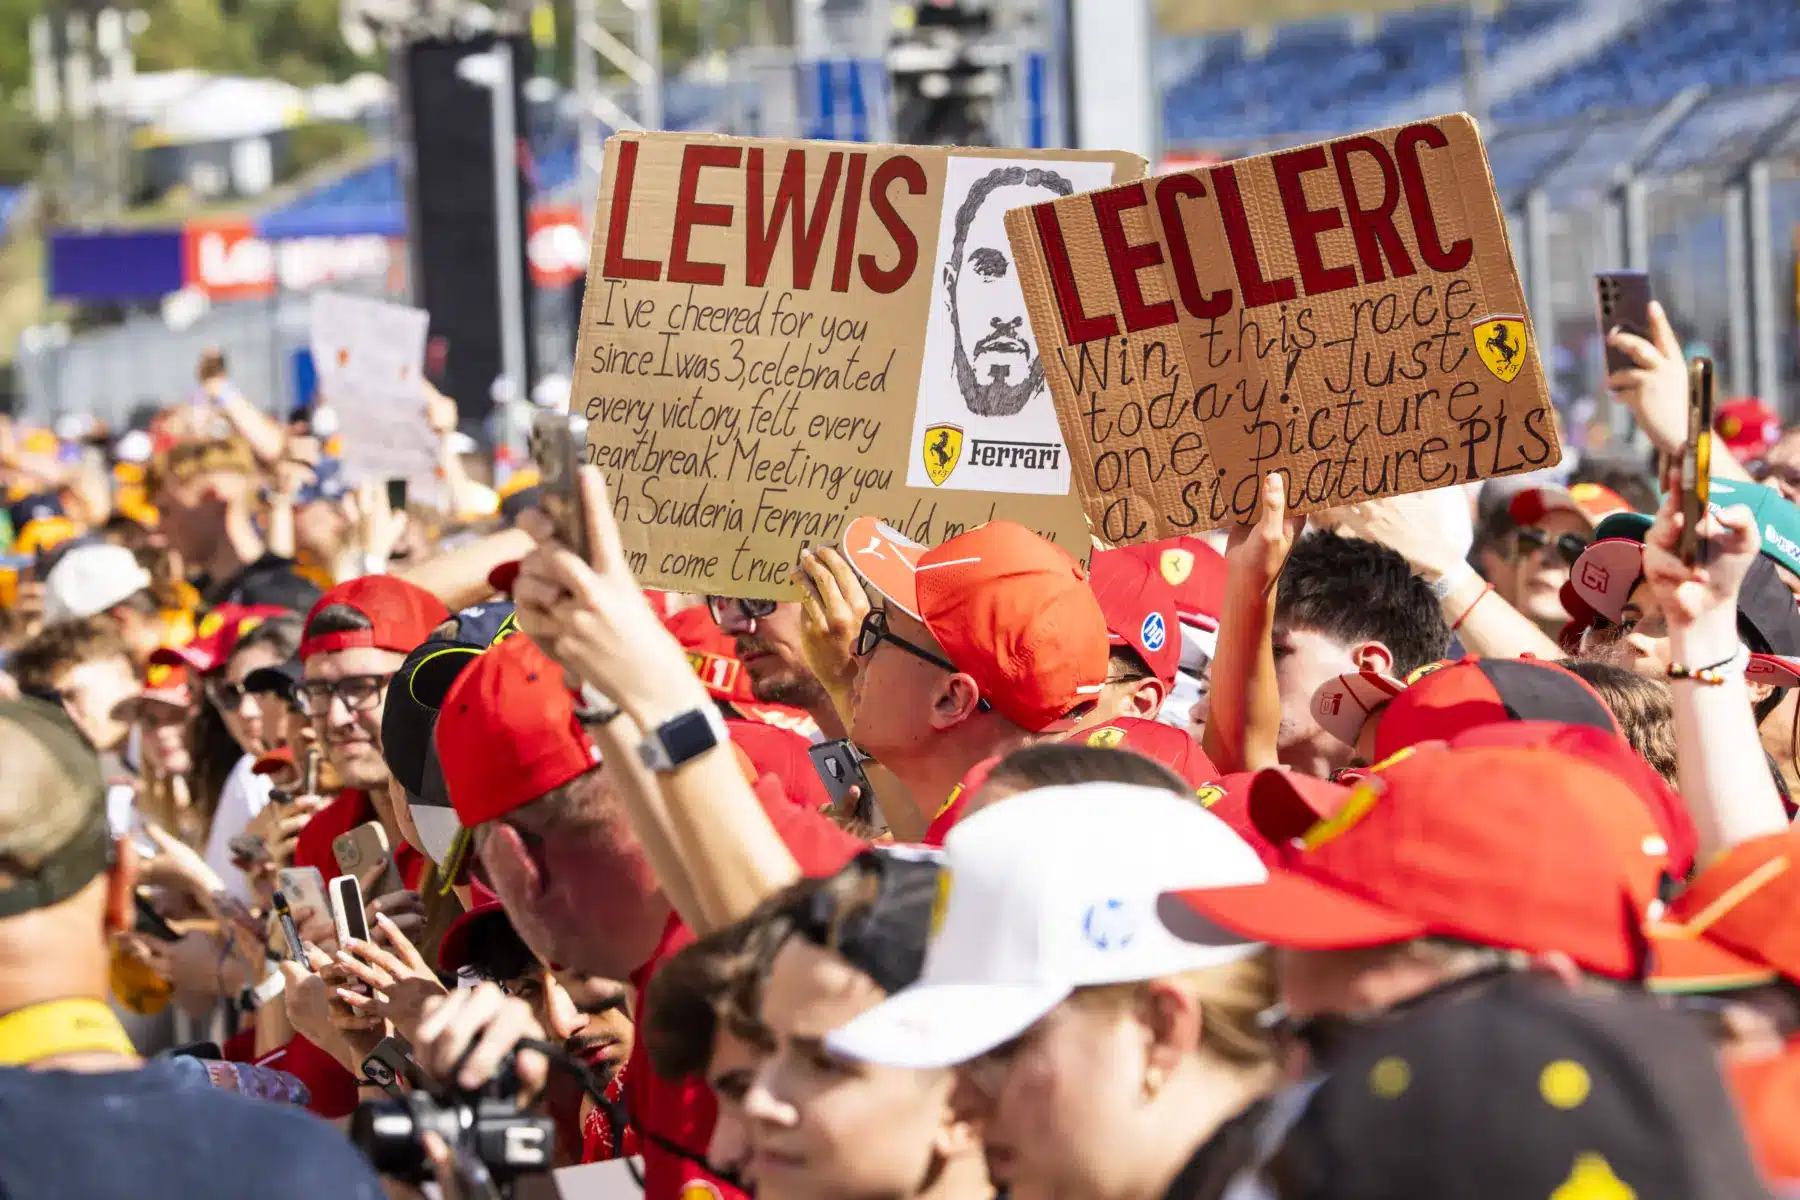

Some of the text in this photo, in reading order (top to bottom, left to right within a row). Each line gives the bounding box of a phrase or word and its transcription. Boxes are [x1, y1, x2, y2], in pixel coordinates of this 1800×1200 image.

[602, 140, 928, 294] LEWIS
[1032, 122, 1473, 346] LECLERC
[596, 279, 869, 354] I've cheered for you
[1057, 279, 1477, 396] Win this race
[591, 342, 654, 377] since
[676, 350, 720, 382] was
[748, 341, 897, 393] celebrated
[1320, 319, 1469, 394] Just
[585, 385, 882, 454] every victory, felt every
[1094, 381, 1482, 493] one picture
[727, 437, 851, 501] Meeting
[850, 467, 893, 504] you
[968, 439, 1062, 470] Ferrari
[637, 475, 743, 532] Scuderia
[752, 487, 849, 539] Ferrari
[1102, 497, 1147, 543] a
[660, 551, 719, 578] come
[1143, 613, 1165, 648] hp
